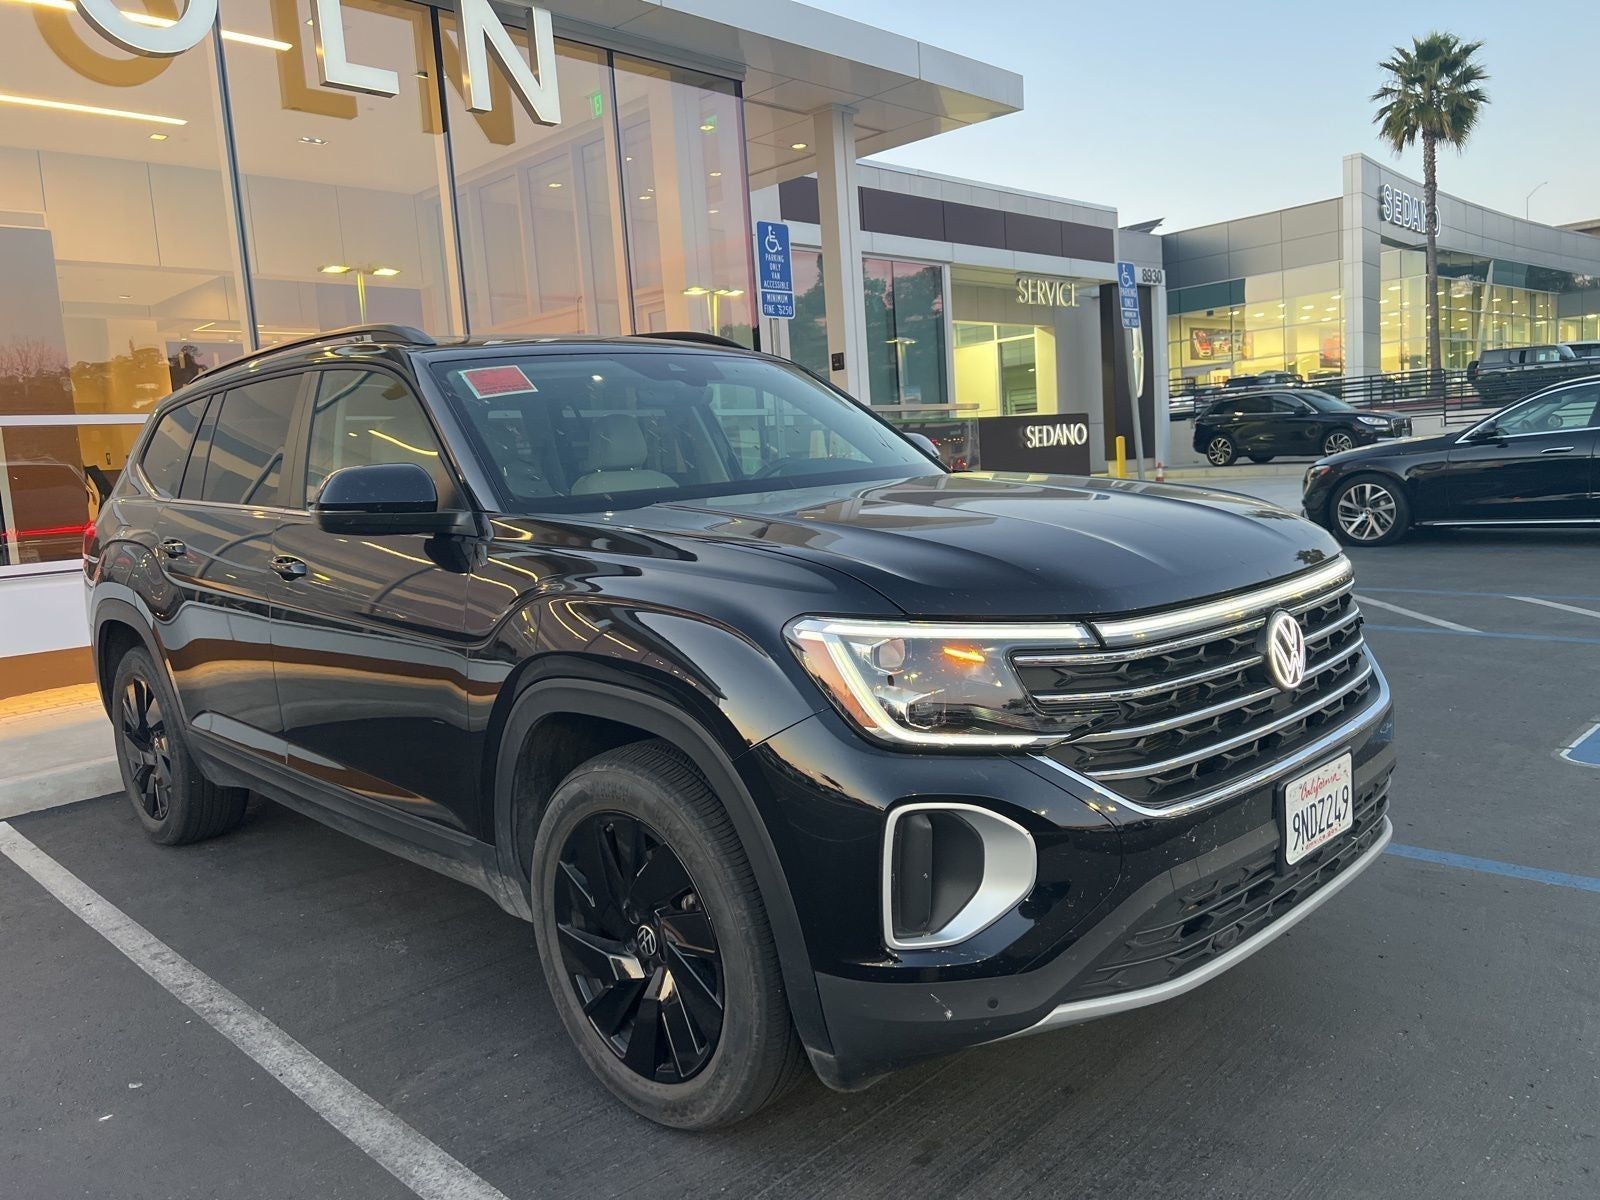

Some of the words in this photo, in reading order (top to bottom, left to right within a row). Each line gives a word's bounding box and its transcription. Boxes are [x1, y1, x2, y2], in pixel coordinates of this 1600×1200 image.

[765, 253, 785, 263] PARKING
[769, 262, 781, 271] ONLY
[771, 271, 781, 279] VAN
[1142, 268, 1162, 284] 8930
[763, 281, 790, 290] ACCESSIBLE
[1017, 278, 1080, 307] SERVICE
[766, 293, 789, 304] MINIMUM
[763, 304, 775, 314] FINE
[777, 305, 792, 315] $250
[1026, 422, 1088, 449] SEDANO
[1299, 772, 1342, 801] California
[1293, 785, 1349, 851] 9NDZ249
